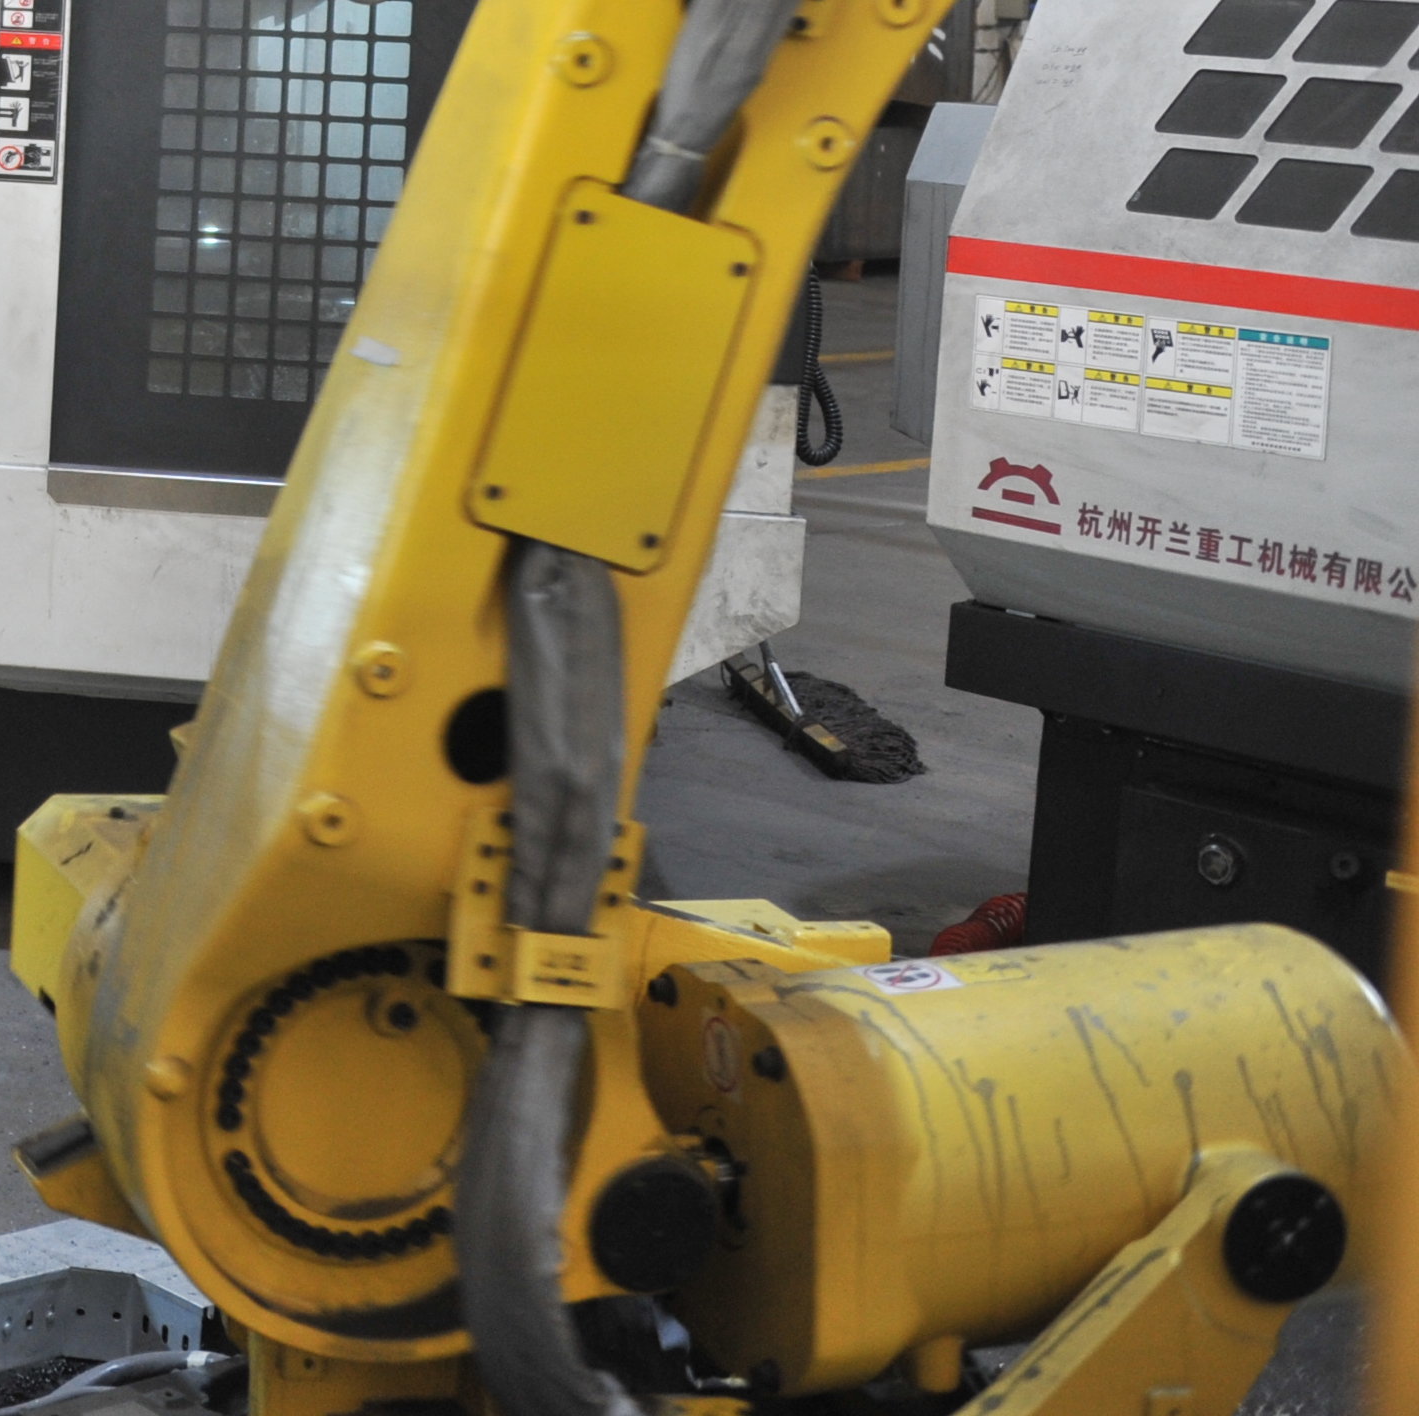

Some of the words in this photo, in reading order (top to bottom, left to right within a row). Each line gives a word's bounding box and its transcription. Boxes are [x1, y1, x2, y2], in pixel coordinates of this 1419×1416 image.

[1077, 502, 1418, 604] 杭州开兰重工机械有限公
